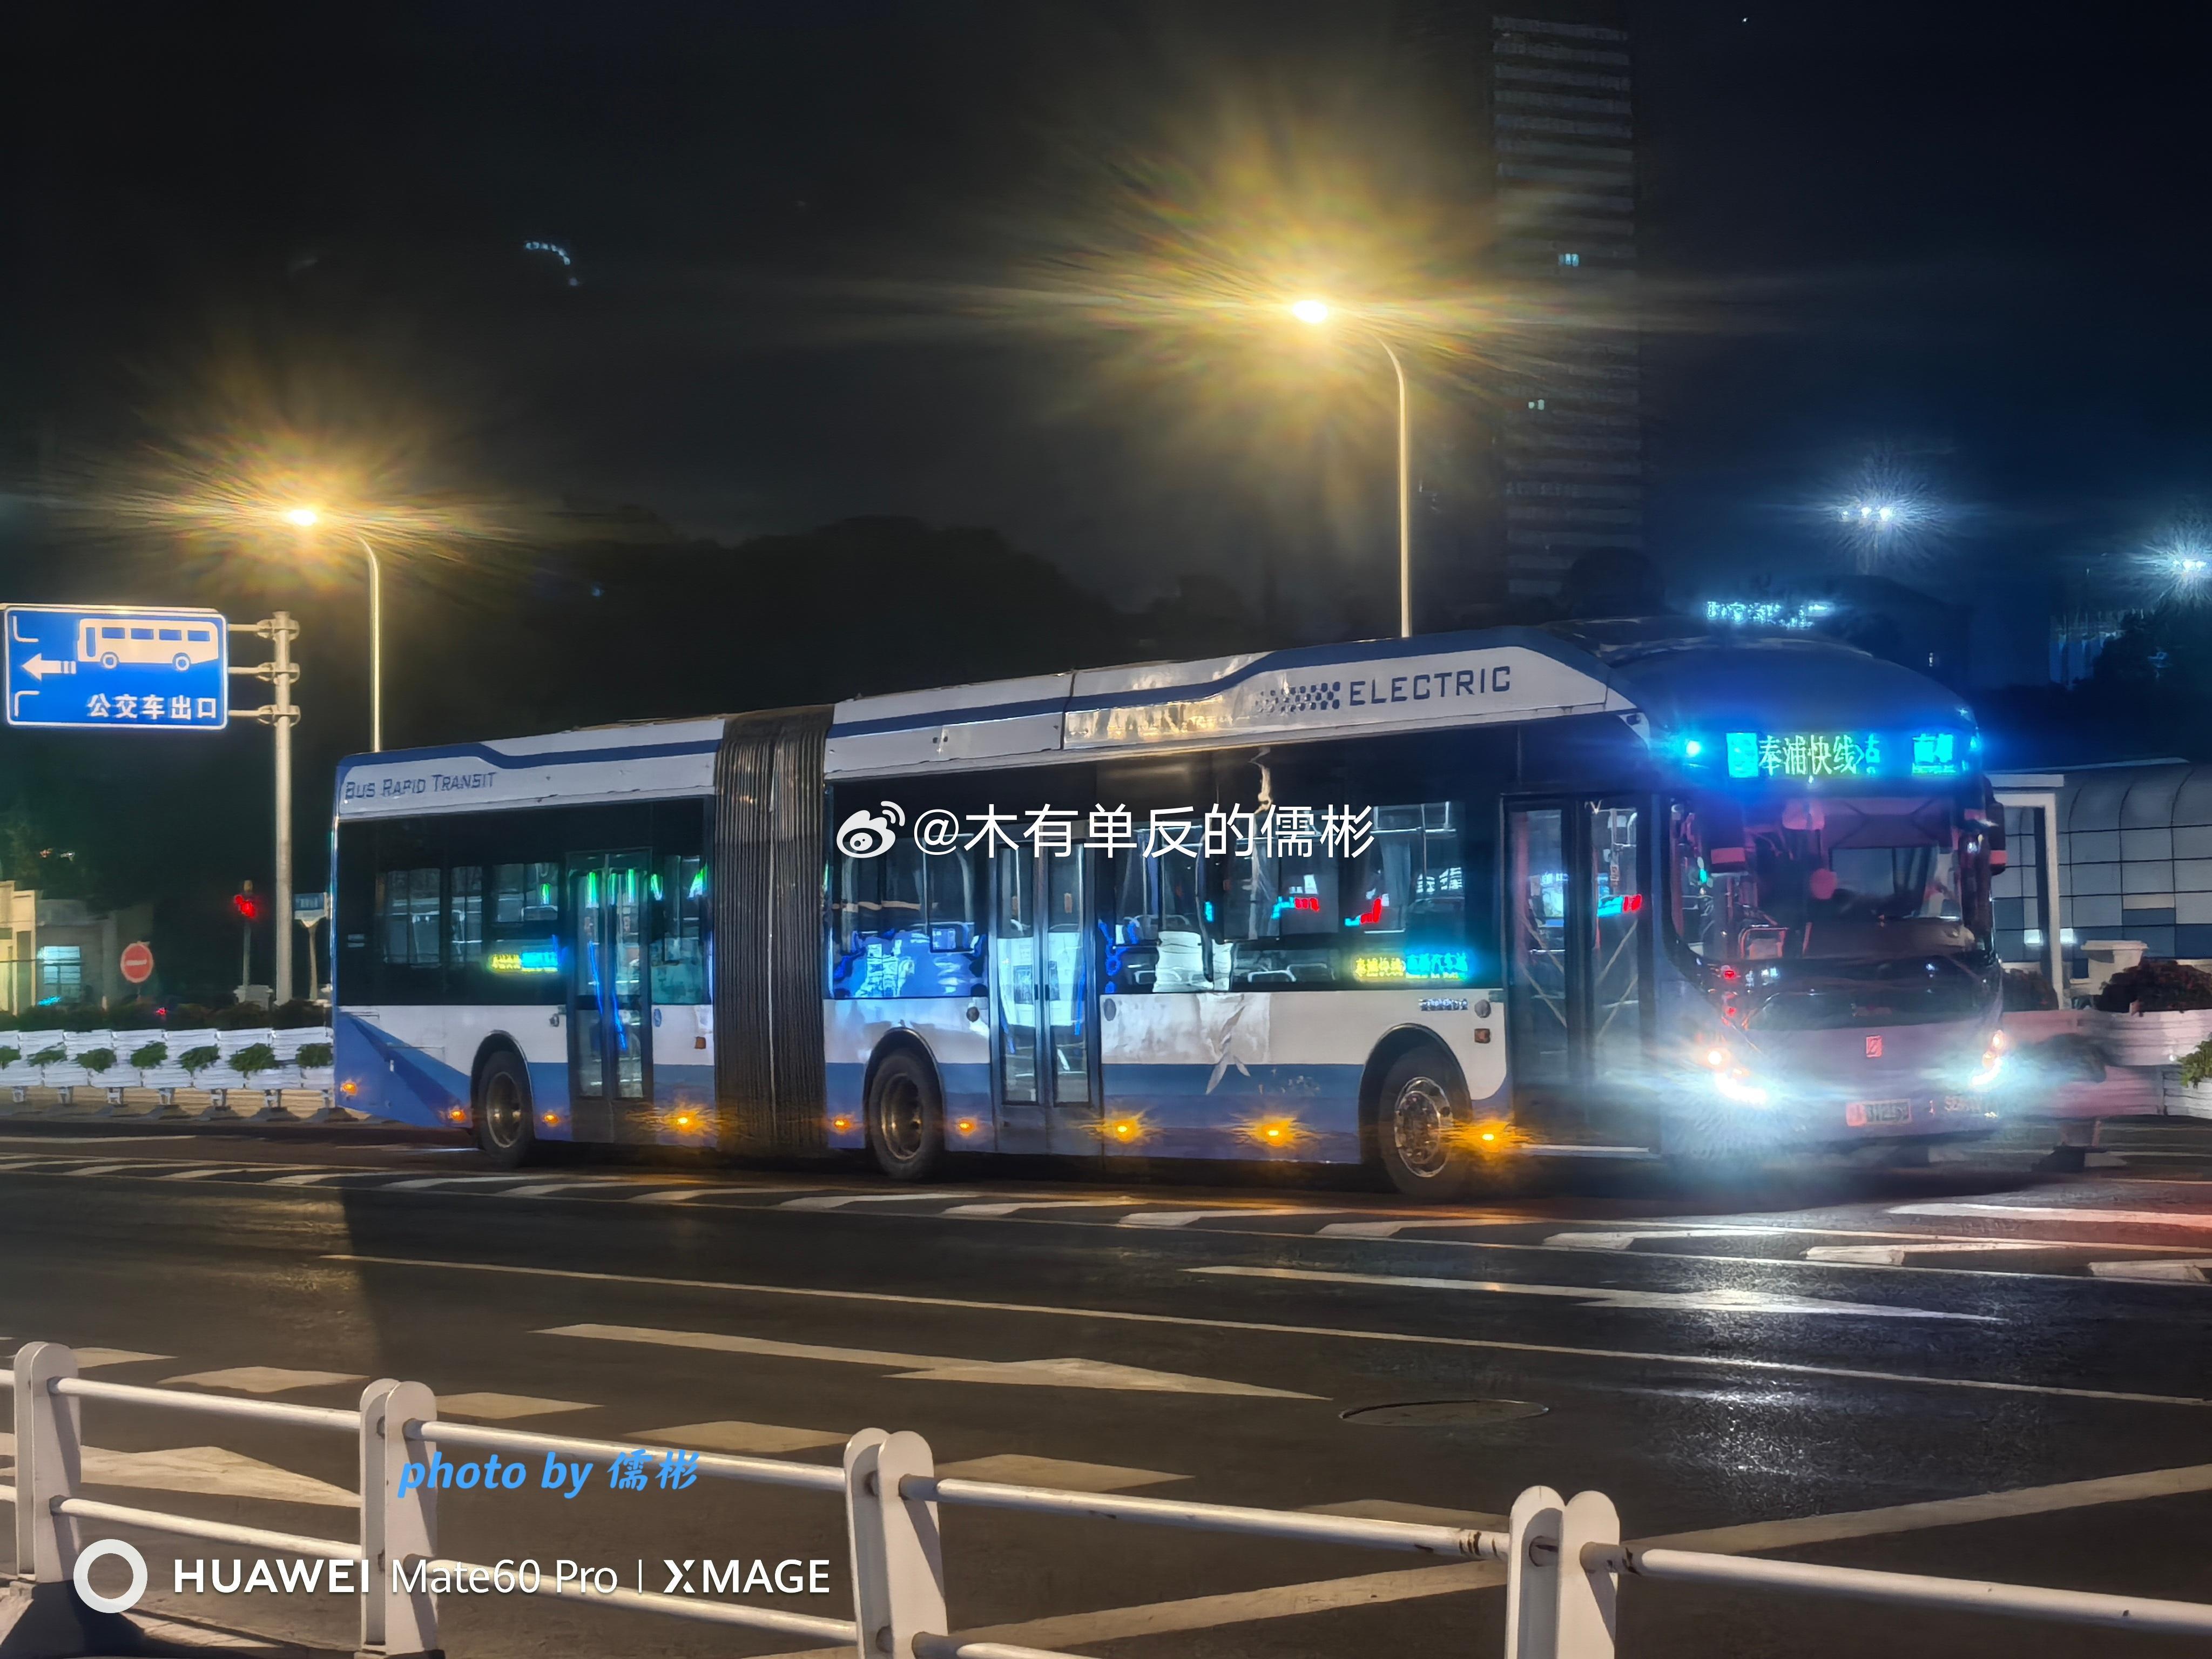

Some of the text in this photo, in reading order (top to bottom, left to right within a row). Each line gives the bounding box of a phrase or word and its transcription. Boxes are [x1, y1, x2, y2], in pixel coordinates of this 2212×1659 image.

[1350, 666, 1510, 706] ELECTRIC
[87, 693, 217, 720] 公交车出口
